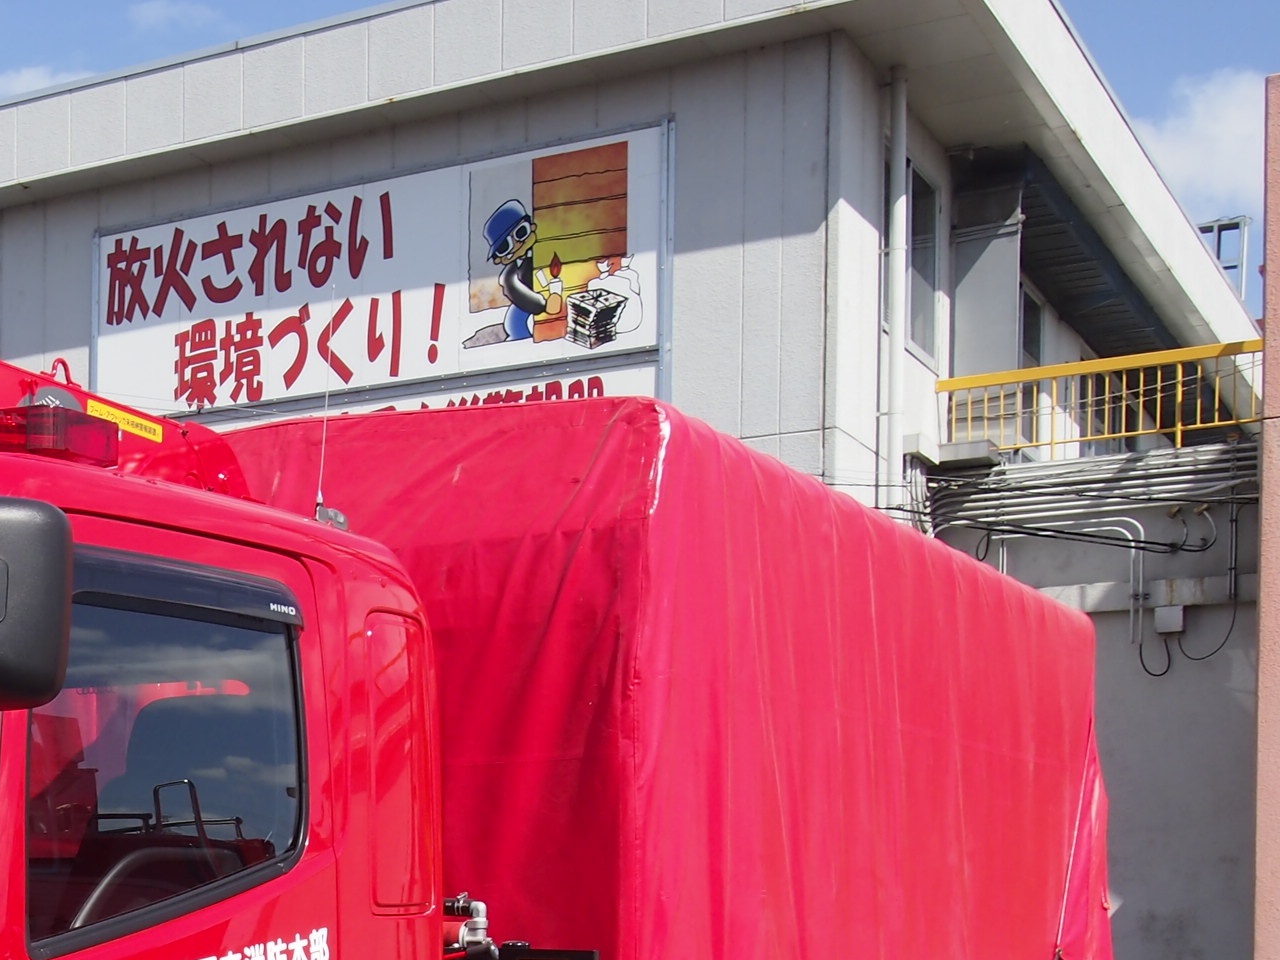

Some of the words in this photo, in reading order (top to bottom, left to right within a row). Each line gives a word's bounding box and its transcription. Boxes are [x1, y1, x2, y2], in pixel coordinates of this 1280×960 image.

[106, 191, 395, 326] 放火されない
[269, 602, 296, 615] HINO
